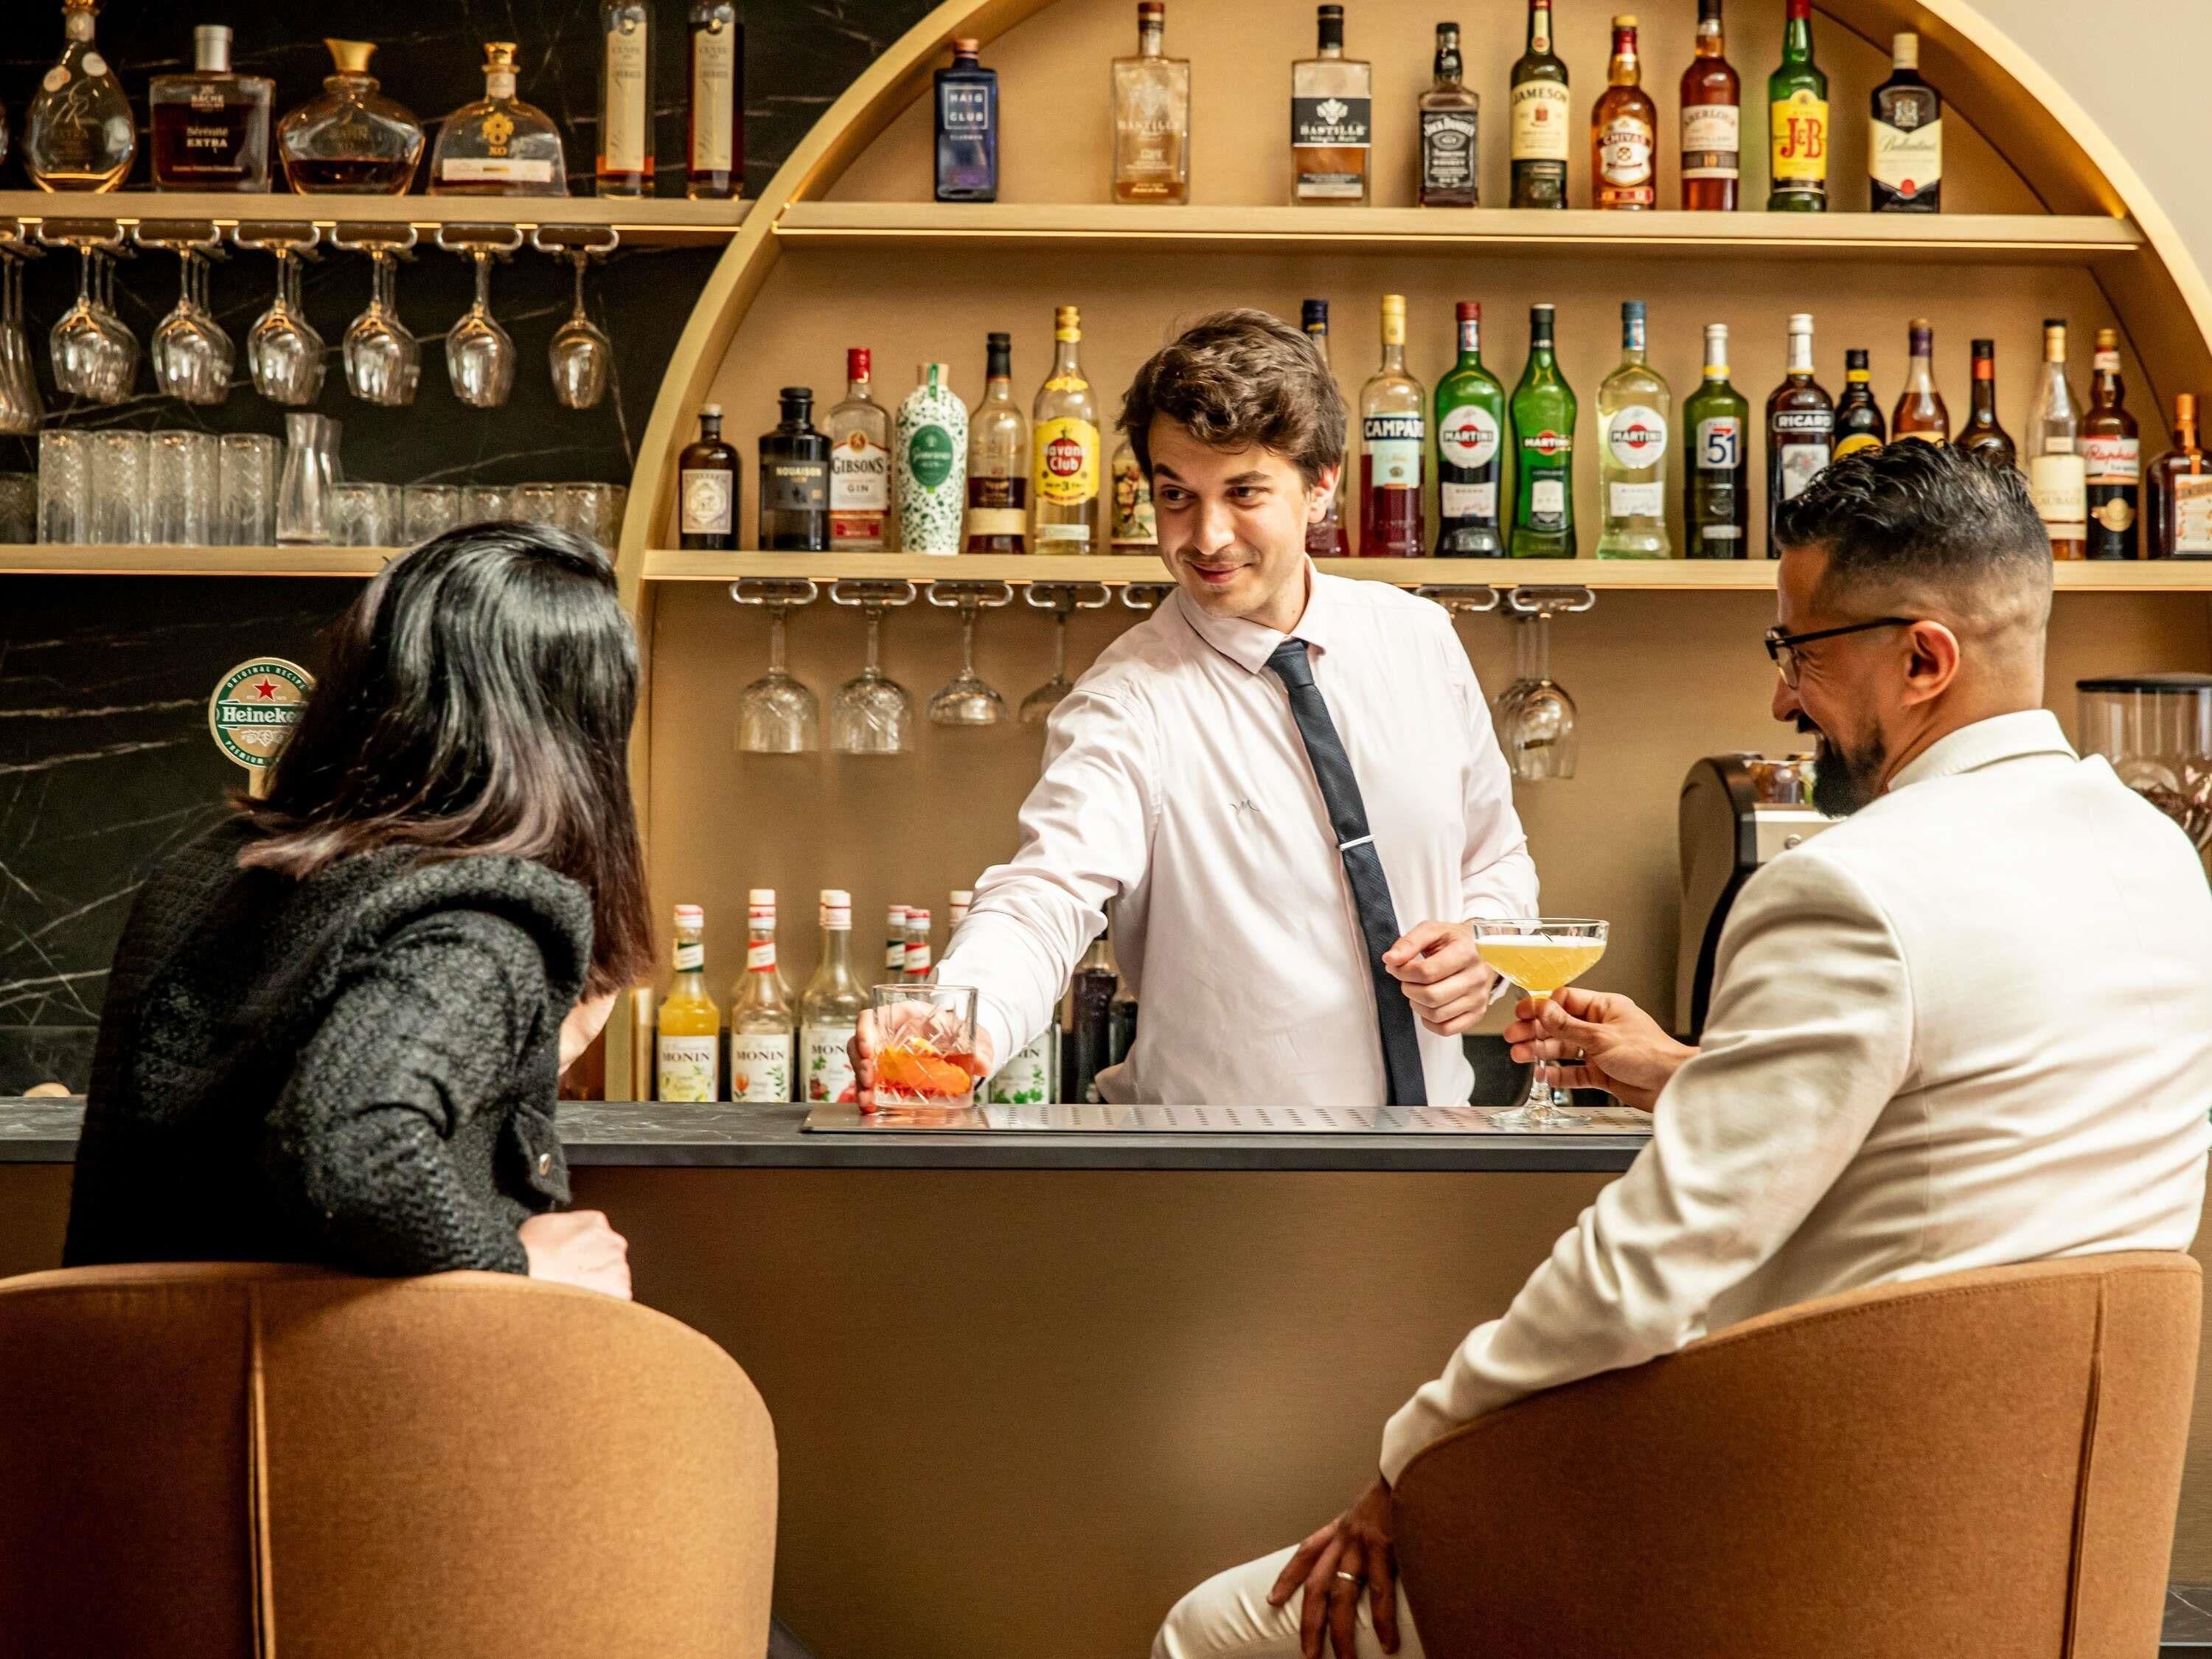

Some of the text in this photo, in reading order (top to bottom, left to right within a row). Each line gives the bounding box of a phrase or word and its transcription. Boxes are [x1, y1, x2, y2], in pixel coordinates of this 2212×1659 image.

[949, 93, 983, 103] HAIG
[1512, 88, 1567, 106] JAMESON
[949, 112, 984, 122] CLUB
[1300, 124, 1365, 136] BASTILLE
[187, 137, 229, 147] EXTRA
[1778, 415, 1832, 427] RICARD
[1444, 431, 1493, 442] MARTINI
[1612, 431, 1661, 442] MARTINI
[1707, 434, 1736, 464] 51
[1049, 456, 1079, 470] Club
[847, 484, 869, 493] GIN
[227, 666, 271, 689] ORIGINAL
[224, 740, 264, 765] PREMIUM
[812, 1044, 846, 1054] MON
[663, 1051, 710, 1062] MONIN
[737, 1050, 785, 1060] MONIN
